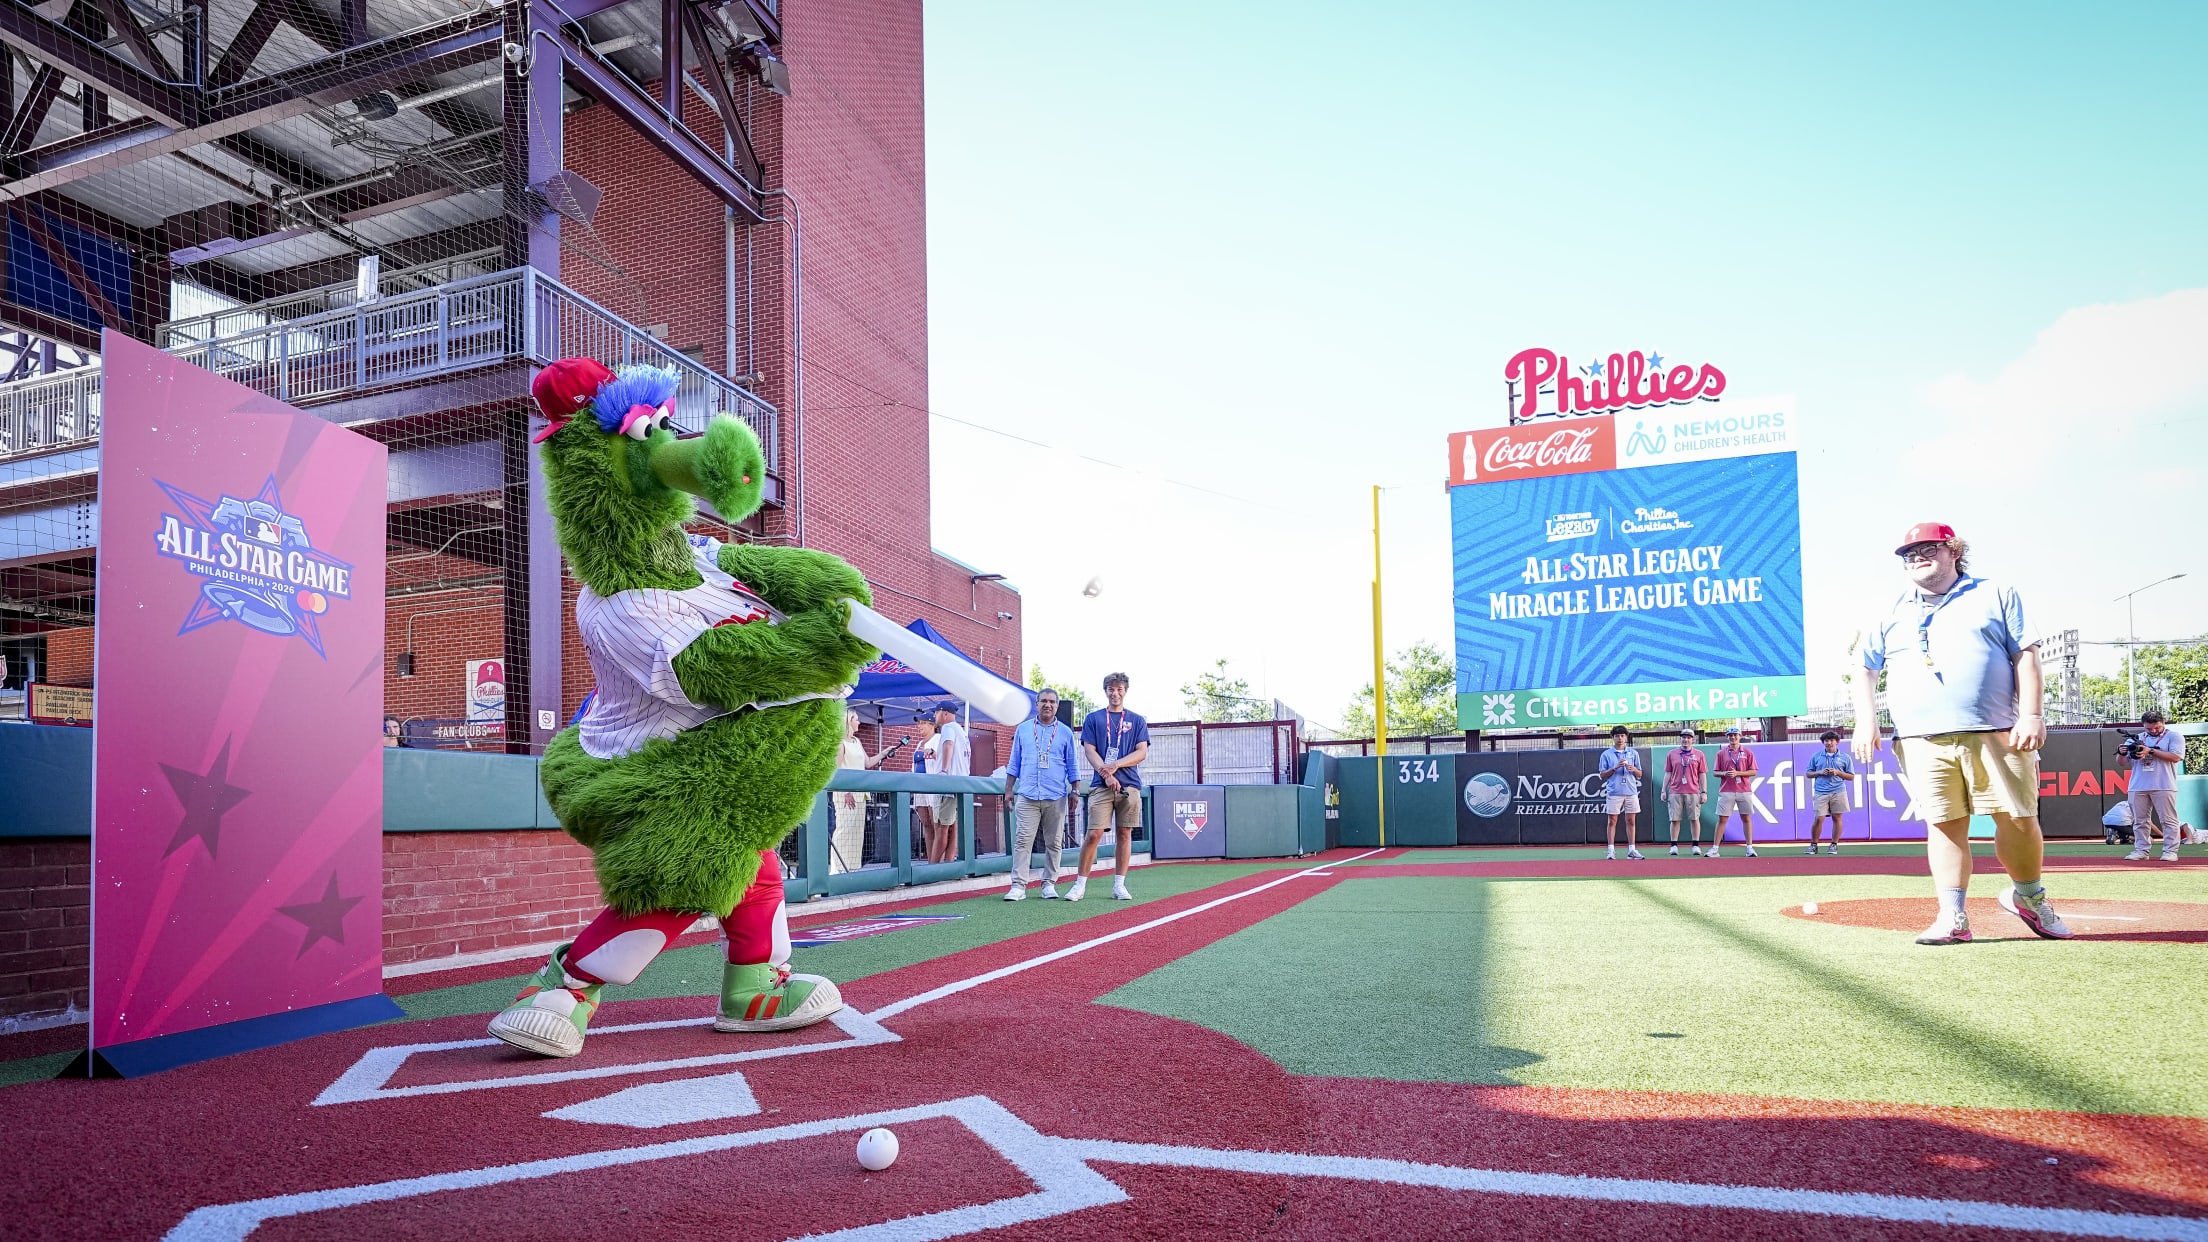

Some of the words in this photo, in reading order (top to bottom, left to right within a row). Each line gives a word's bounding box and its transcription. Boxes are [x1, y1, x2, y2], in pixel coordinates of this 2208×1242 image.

[1504, 347, 1727, 418] Phillies
[1673, 413, 1786, 437] NEMOURS
[1673, 434, 1741, 453] CHILDREN'S
[1742, 430, 1786, 447] HEALTH
[1484, 426, 1598, 472] Coca-Cola
[1634, 507, 1679, 521] Phillies
[157, 516, 215, 563] ALL
[219, 532, 284, 579] STAR
[287, 551, 349, 596] GAME
[1521, 556, 1568, 585] ALL
[1570, 552, 1629, 581] STAR
[1632, 545, 1723, 576] LEGACY
[189, 562, 264, 588] PHILADELPHIA
[271, 581, 295, 595] 2026
[1489, 589, 1590, 620] MIRACLE
[1595, 582, 1688, 614] LEAGUE
[1693, 576, 1763, 605] GAME
[1525, 696, 1629, 718] Citizens
[1635, 690, 1702, 714] Bank
[1709, 685, 1768, 709] Park
[438, 726, 455, 737] FAN
[1399, 760, 1440, 784] 334
[1175, 803, 1206, 814] MLB
